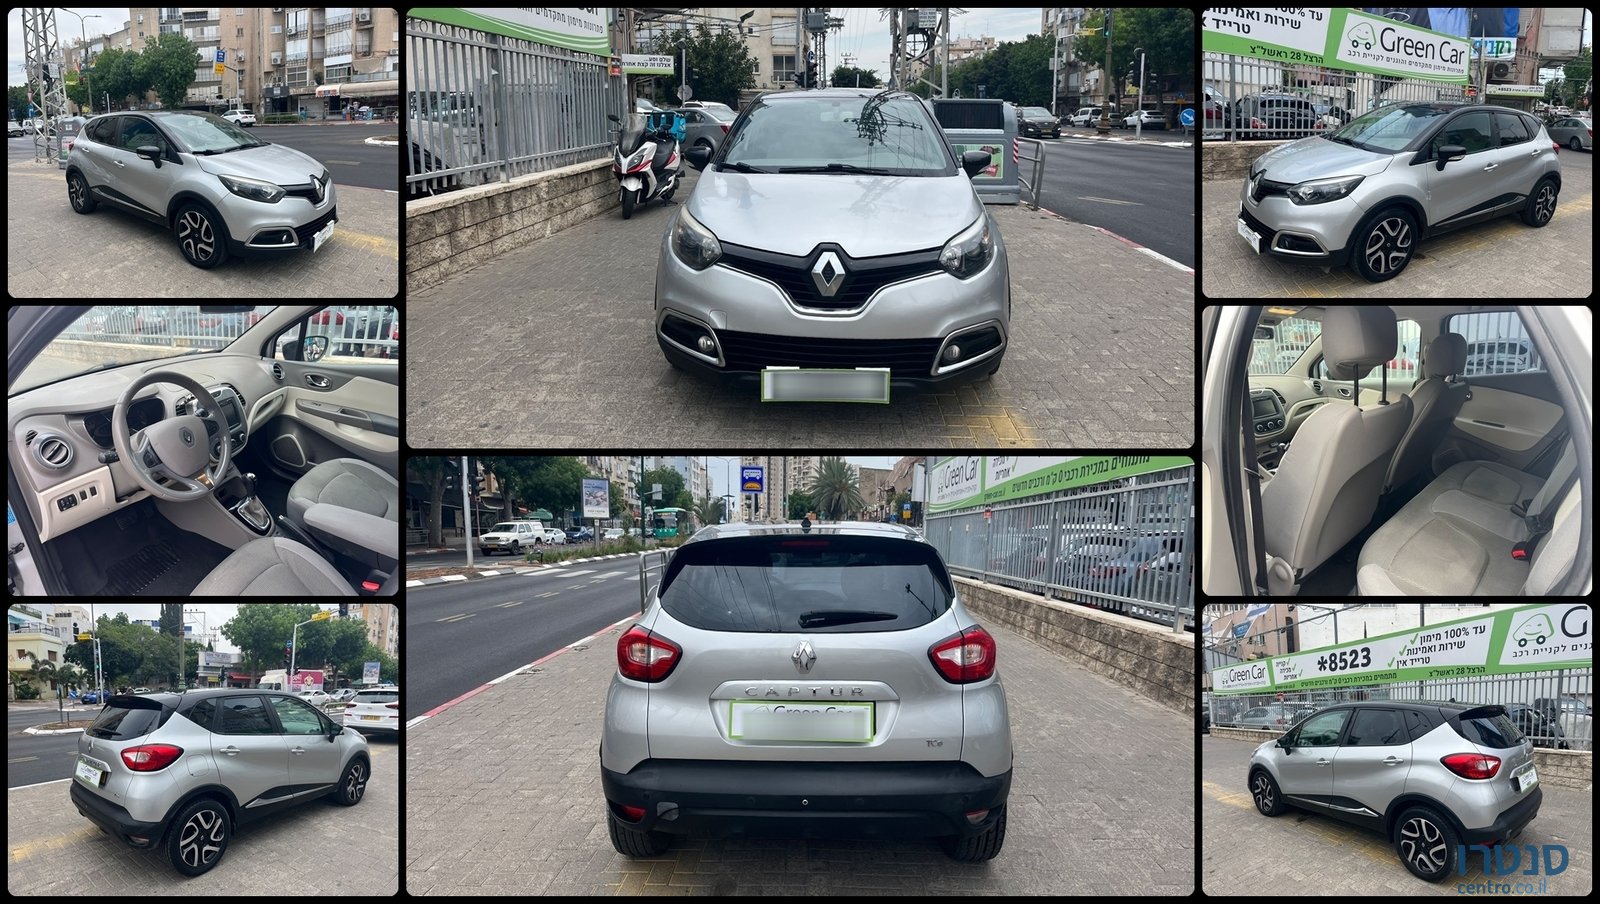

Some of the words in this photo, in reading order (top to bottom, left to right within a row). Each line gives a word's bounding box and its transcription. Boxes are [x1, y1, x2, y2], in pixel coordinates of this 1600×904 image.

[1264, 13, 1301, 29] שירות
[1308, 10, 1322, 21] עד
[1212, 18, 1250, 34] טרייד
[1380, 27, 1435, 60] Green
[1440, 41, 1465, 65] Car
[1290, 51, 1301, 60] 28
[1304, 52, 1324, 63] הרצל
[1363, 52, 1384, 62] לקניית
[944, 465, 964, 488] Green
[965, 456, 979, 481] Car
[1080, 460, 1109, 478] במכירת
[1444, 627, 1469, 639] 100%
[1473, 625, 1486, 635] עד
[1420, 633, 1441, 645] מימון
[1406, 645, 1436, 656] ואמינות
[1438, 640, 1465, 651] שירות
[1533, 644, 1567, 655] לקניית
[1397, 659, 1407, 669] אין
[1409, 656, 1430, 666] טרייד
[1229, 669, 1250, 682] Green
[1252, 665, 1266, 679] Car
[1467, 666, 1485, 674] הרצל
[744, 686, 864, 696] CAPTUR
